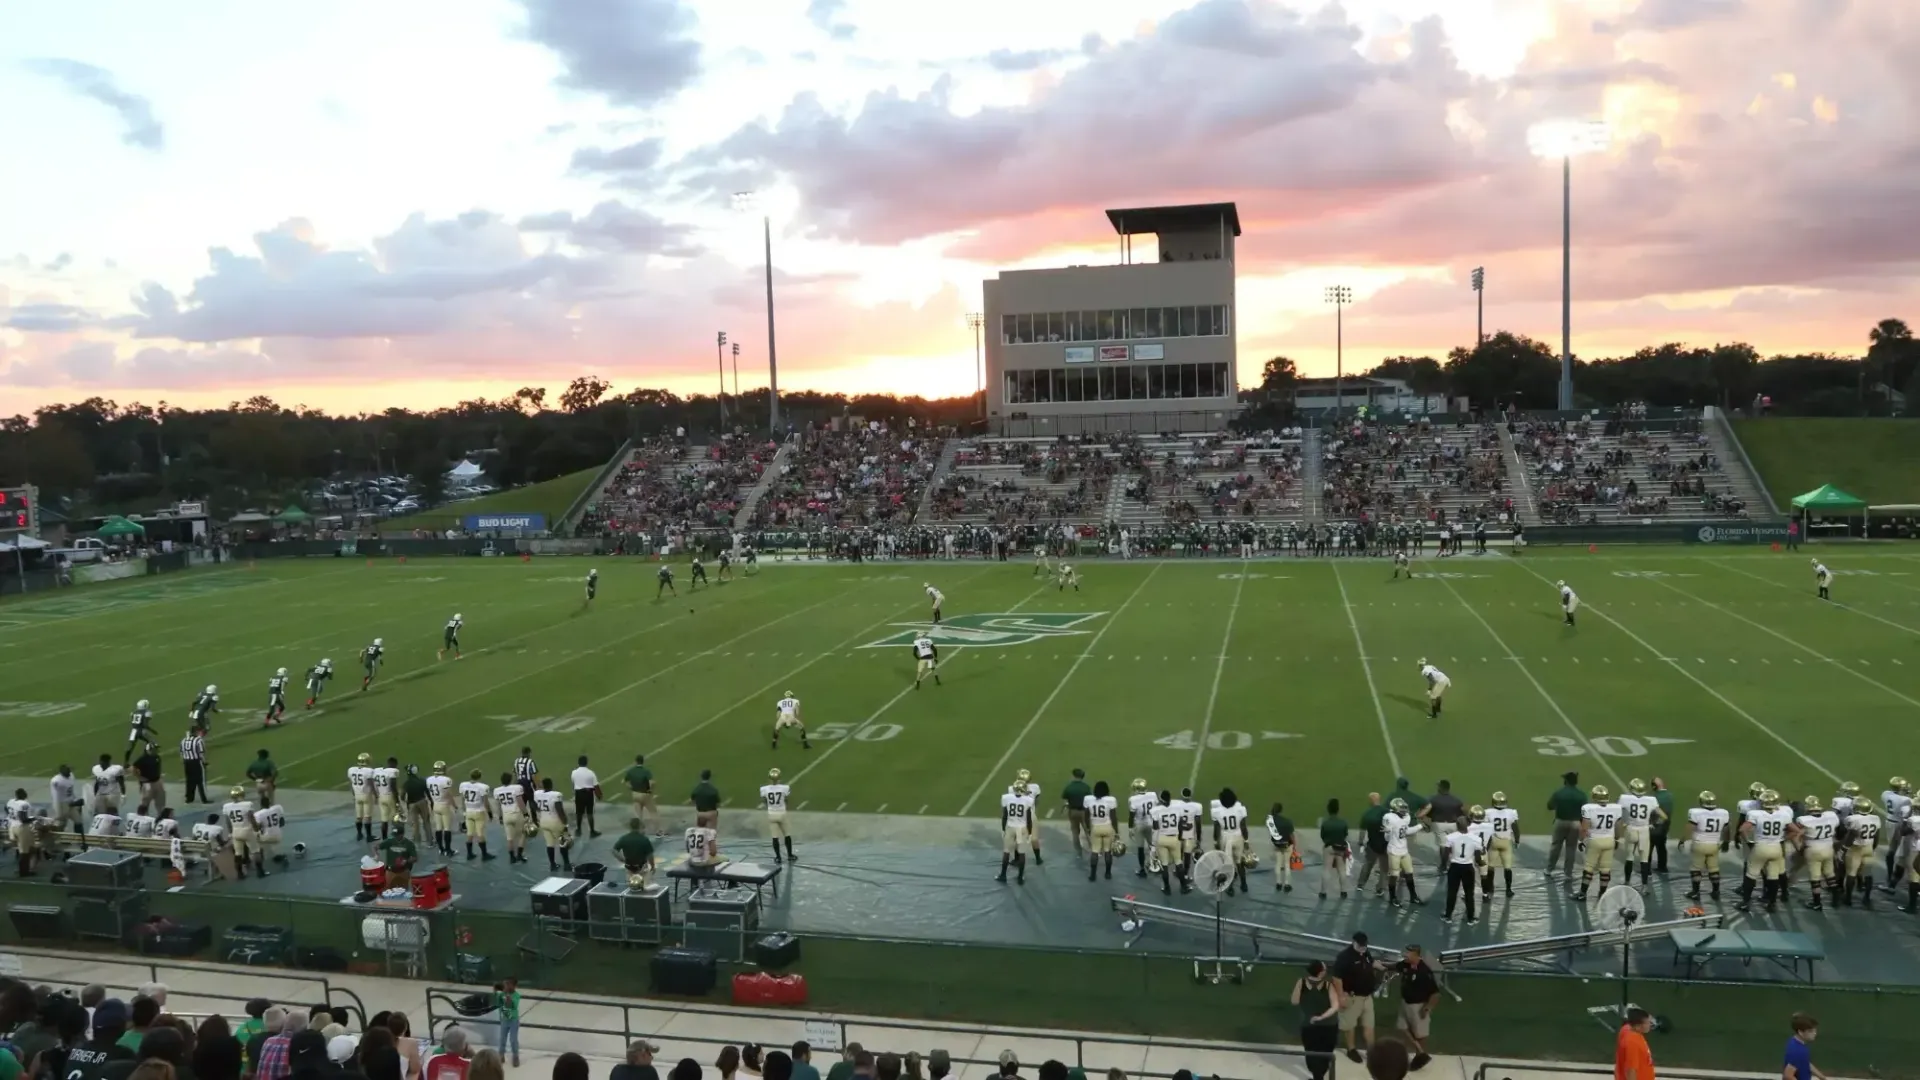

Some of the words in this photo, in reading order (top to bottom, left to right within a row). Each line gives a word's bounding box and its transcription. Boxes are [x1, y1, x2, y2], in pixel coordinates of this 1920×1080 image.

[478, 518, 500, 528] BUD
[500, 518, 530, 528] LIGHT
[132, 713, 142, 725] 13
[806, 722, 904, 741] 50
[1153, 729, 1252, 750] 40
[1531, 735, 1648, 756] 30
[352, 773, 364, 786] 35
[429, 784, 440, 796] 43
[464, 790, 476, 802] 47
[499, 792, 514, 805] 25
[768, 792, 782, 805] 97
[229, 809, 244, 823] 45
[1009, 803, 1024, 817] 89
[1092, 804, 1105, 818] 16
[1630, 803, 1647, 819] 83
[127, 819, 141, 834] 94
[267, 813, 279, 828] 15
[1162, 813, 1177, 828] 53
[1223, 815, 1236, 830] 10
[1494, 818, 1508, 832] 21
[1596, 814, 1613, 829] 76
[1705, 818, 1720, 832] 51
[1763, 821, 1781, 836] 98
[1815, 824, 1832, 840] 72
[1861, 824, 1876, 839] 22
[689, 834, 704, 849] 32
[1460, 843, 1466, 858] 1
[93, 1051, 108, 1064] JR
